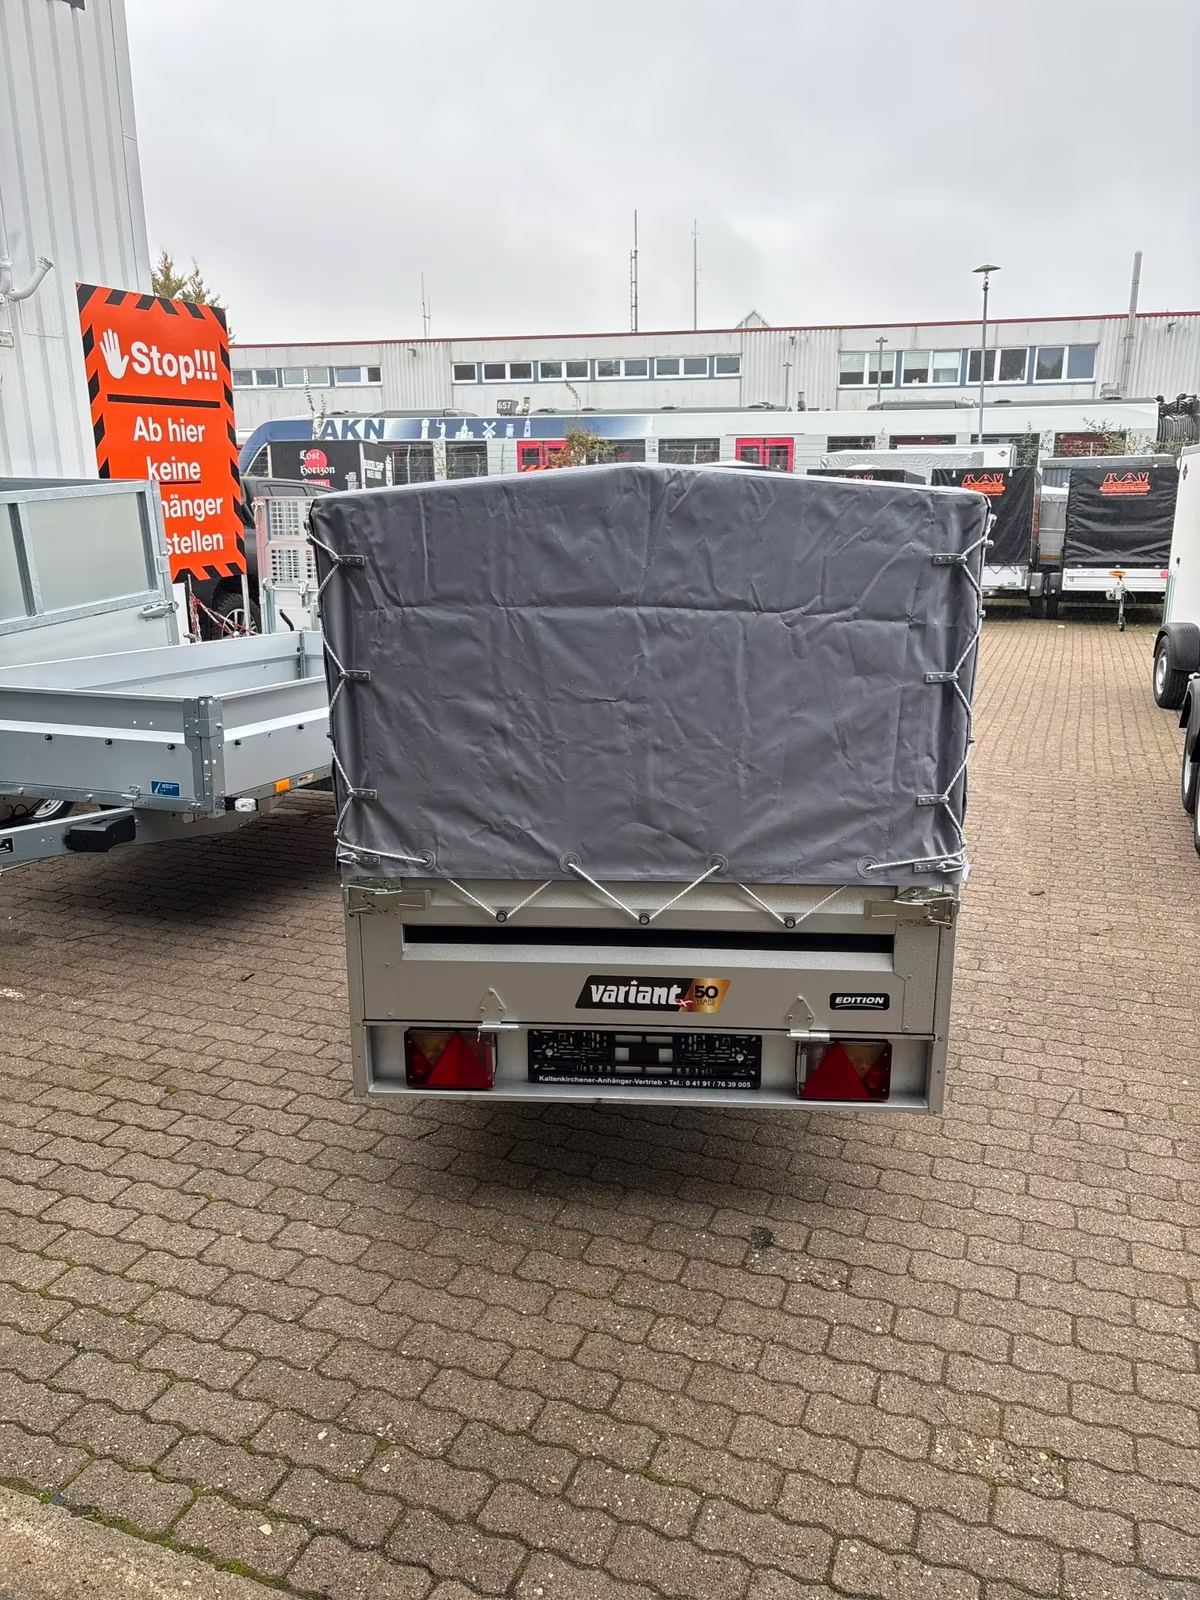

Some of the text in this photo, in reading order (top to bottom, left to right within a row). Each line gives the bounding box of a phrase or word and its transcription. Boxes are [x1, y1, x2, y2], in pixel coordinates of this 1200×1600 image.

[130, 341, 218, 385] Stop!!!
[497, 401, 511, 410] 657
[133, 416, 205, 443] Ab hier
[319, 419, 385, 440] AKN
[300, 449, 321, 460] Lost
[146, 455, 201, 480] keine
[300, 464, 336, 476] Horizon
[590, 979, 682, 1006] variant
[694, 985, 719, 999] 50
[835, 996, 885, 1004] EDITION
